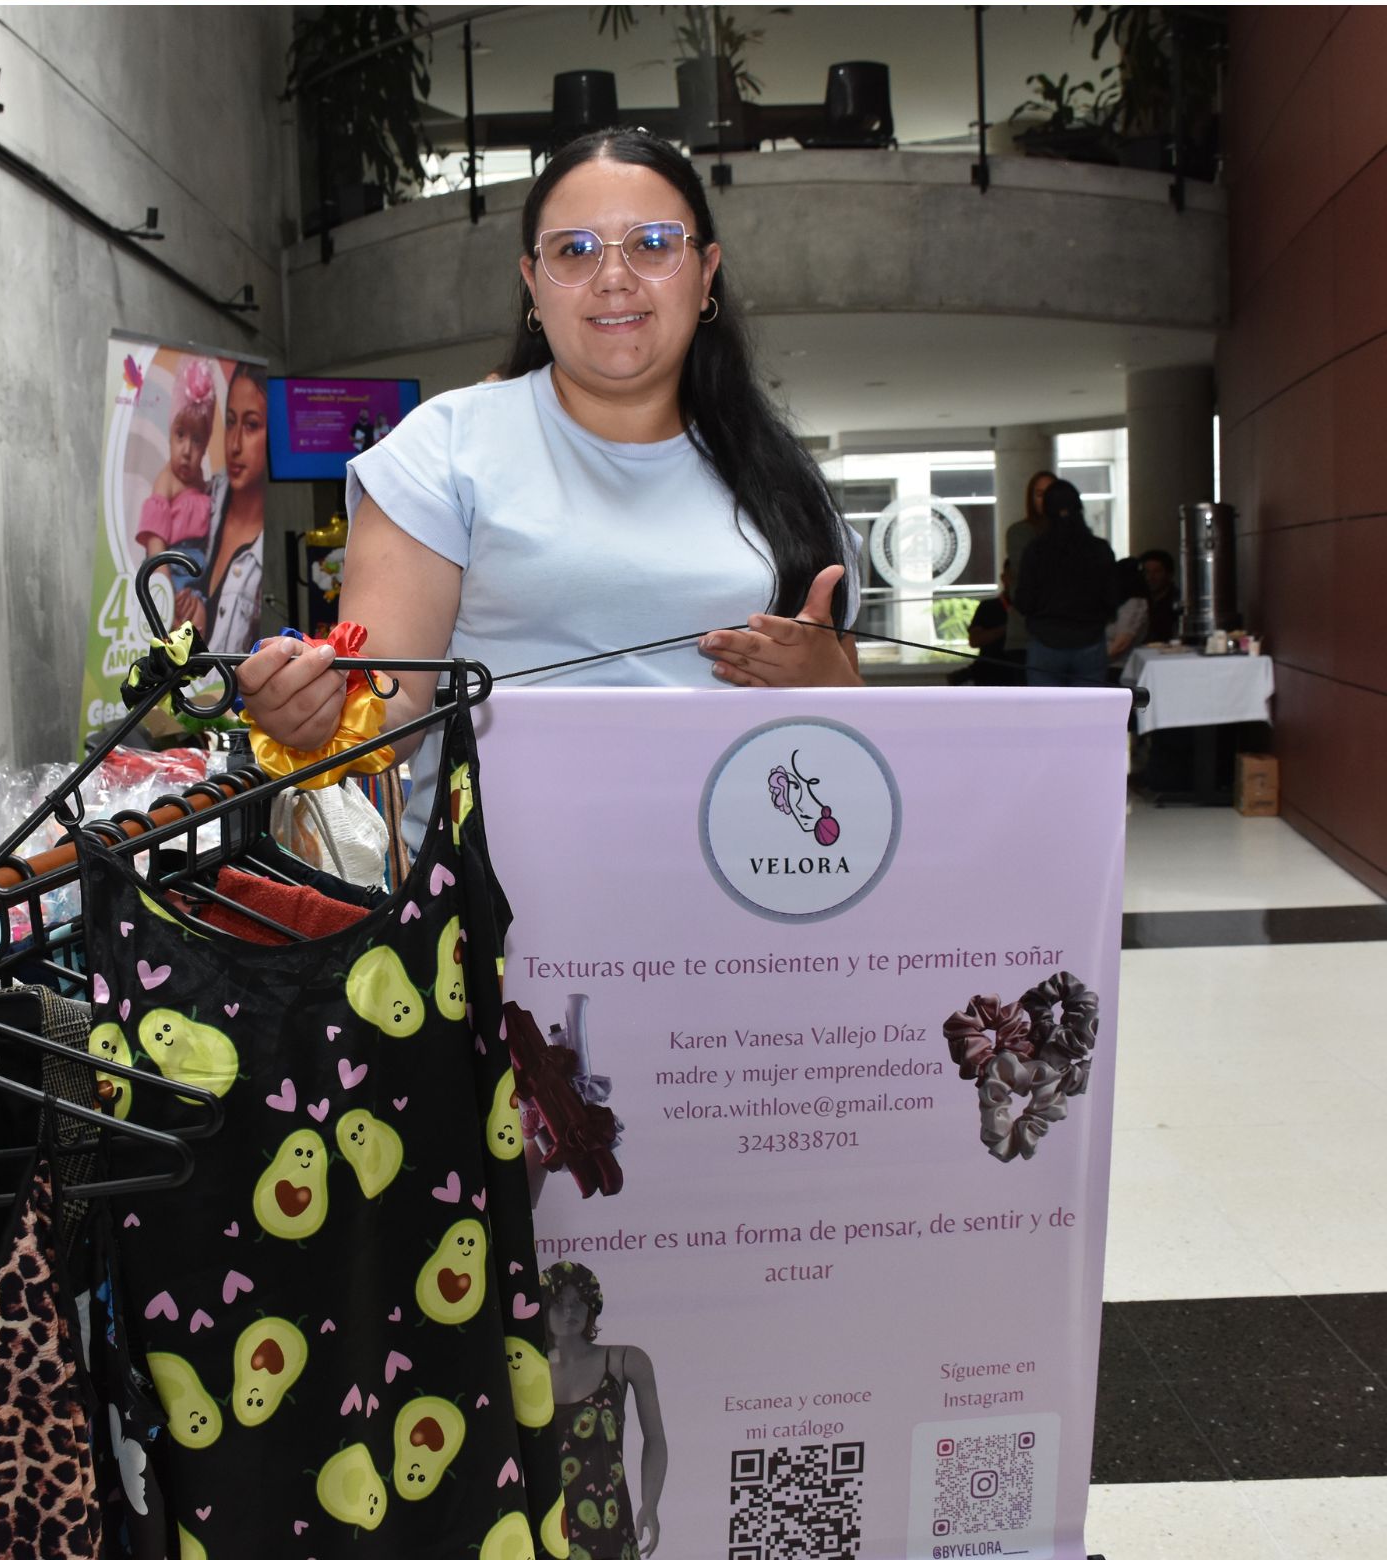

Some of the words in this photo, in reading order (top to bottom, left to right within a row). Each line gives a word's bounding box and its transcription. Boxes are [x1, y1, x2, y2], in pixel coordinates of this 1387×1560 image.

[749, 856, 851, 875] VELORA
[524, 955, 625, 979] Texturas
[632, 959, 675, 982] que
[684, 956, 707, 975] te
[714, 953, 839, 974] consienten
[847, 956, 860, 977] y
[867, 953, 890, 972] te
[897, 950, 997, 975] permiten
[1004, 946, 1064, 968] soñar
[669, 1030, 727, 1050] Karen
[735, 1028, 804, 1049] Vanesa
[811, 1025, 877, 1049] Vallejo
[883, 1023, 927, 1043] Díaz
[656, 1067, 718, 1086] madre
[724, 1069, 735, 1089] y
[742, 1065, 799, 1090] mujer
[804, 1059, 943, 1084] emprendedora
[663, 1094, 934, 1120] velora.withlove@gmail.com
[738, 1130, 859, 1154] 3243838701
[940, 1361, 1011, 1381] Sígueme
[1015, 1359, 1036, 1374] en
[724, 1395, 793, 1412] Escanea
[796, 1396, 809, 1411] y
[813, 1389, 872, 1406] conoce
[944, 1388, 1024, 1409] Instagram
[746, 1425, 767, 1440] mi
[772, 1419, 844, 1443] catálogo
